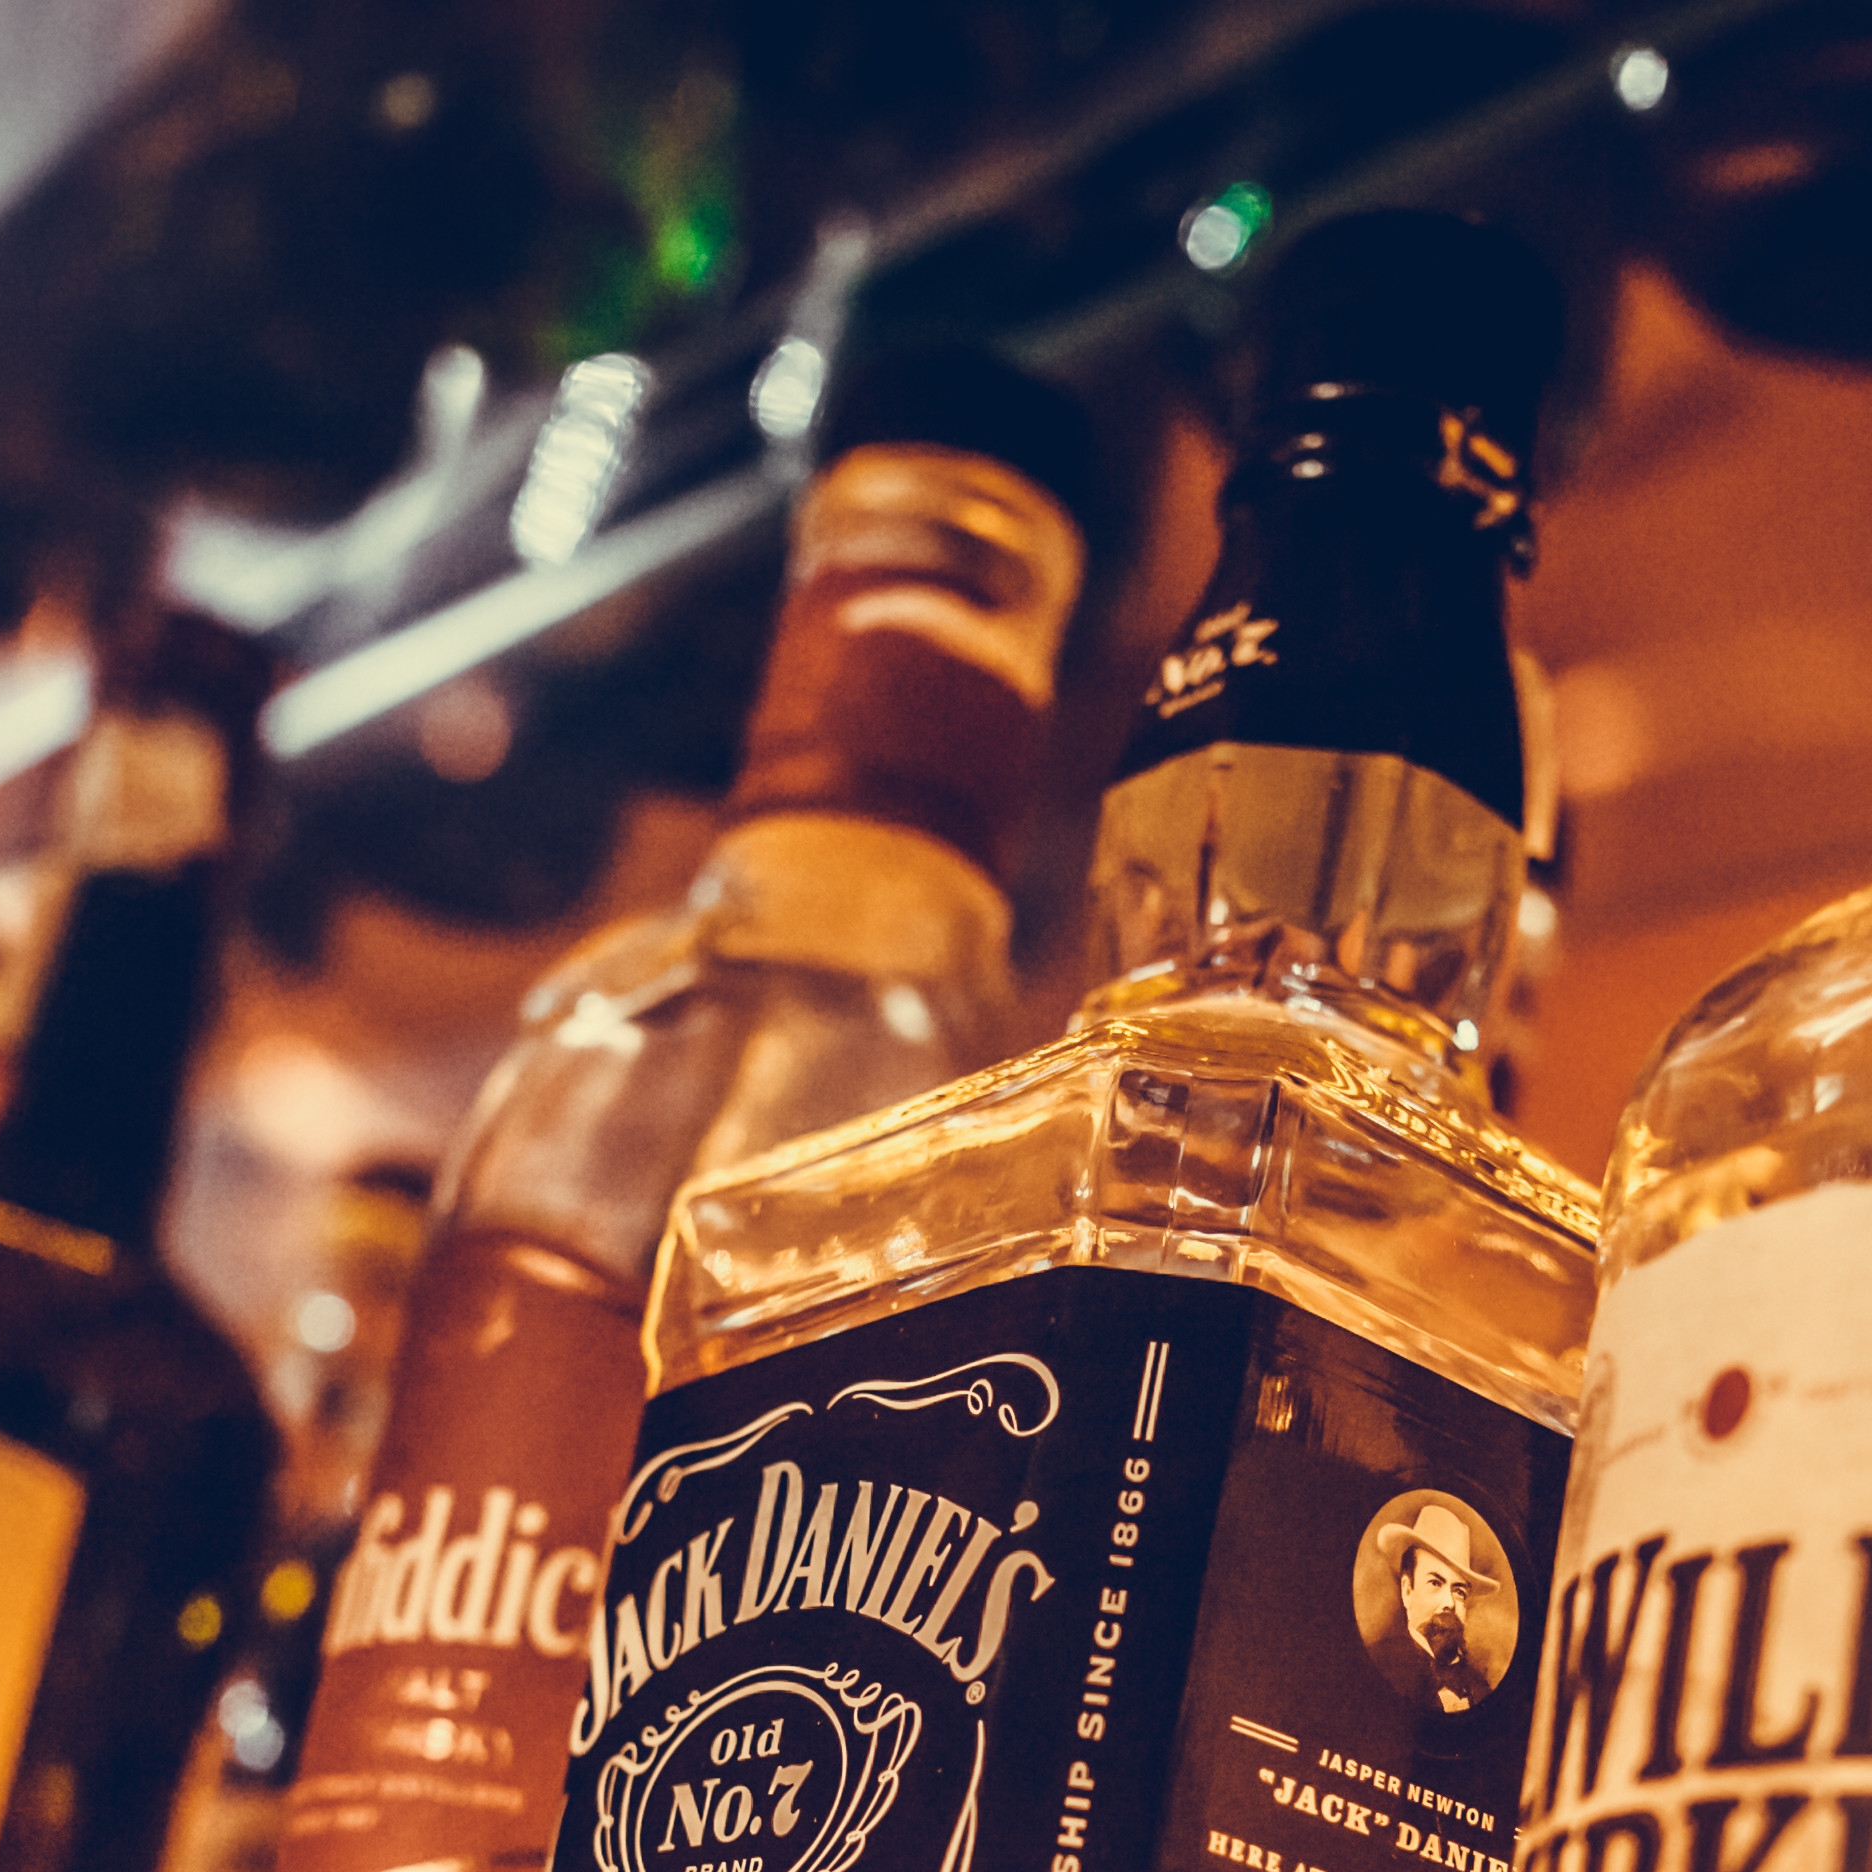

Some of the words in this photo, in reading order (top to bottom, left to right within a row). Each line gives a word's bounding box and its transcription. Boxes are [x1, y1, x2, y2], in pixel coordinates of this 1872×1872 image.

[569, 1516, 735, 1757] JACK
[734, 1461, 1056, 1683] DANIEL'S
[1077, 1586, 1128, 1742] SINCE
[1108, 1457, 1152, 1567] 1866
[1319, 1749, 1402, 1795] JASPER
[1407, 1783, 1495, 1832] NEWTON
